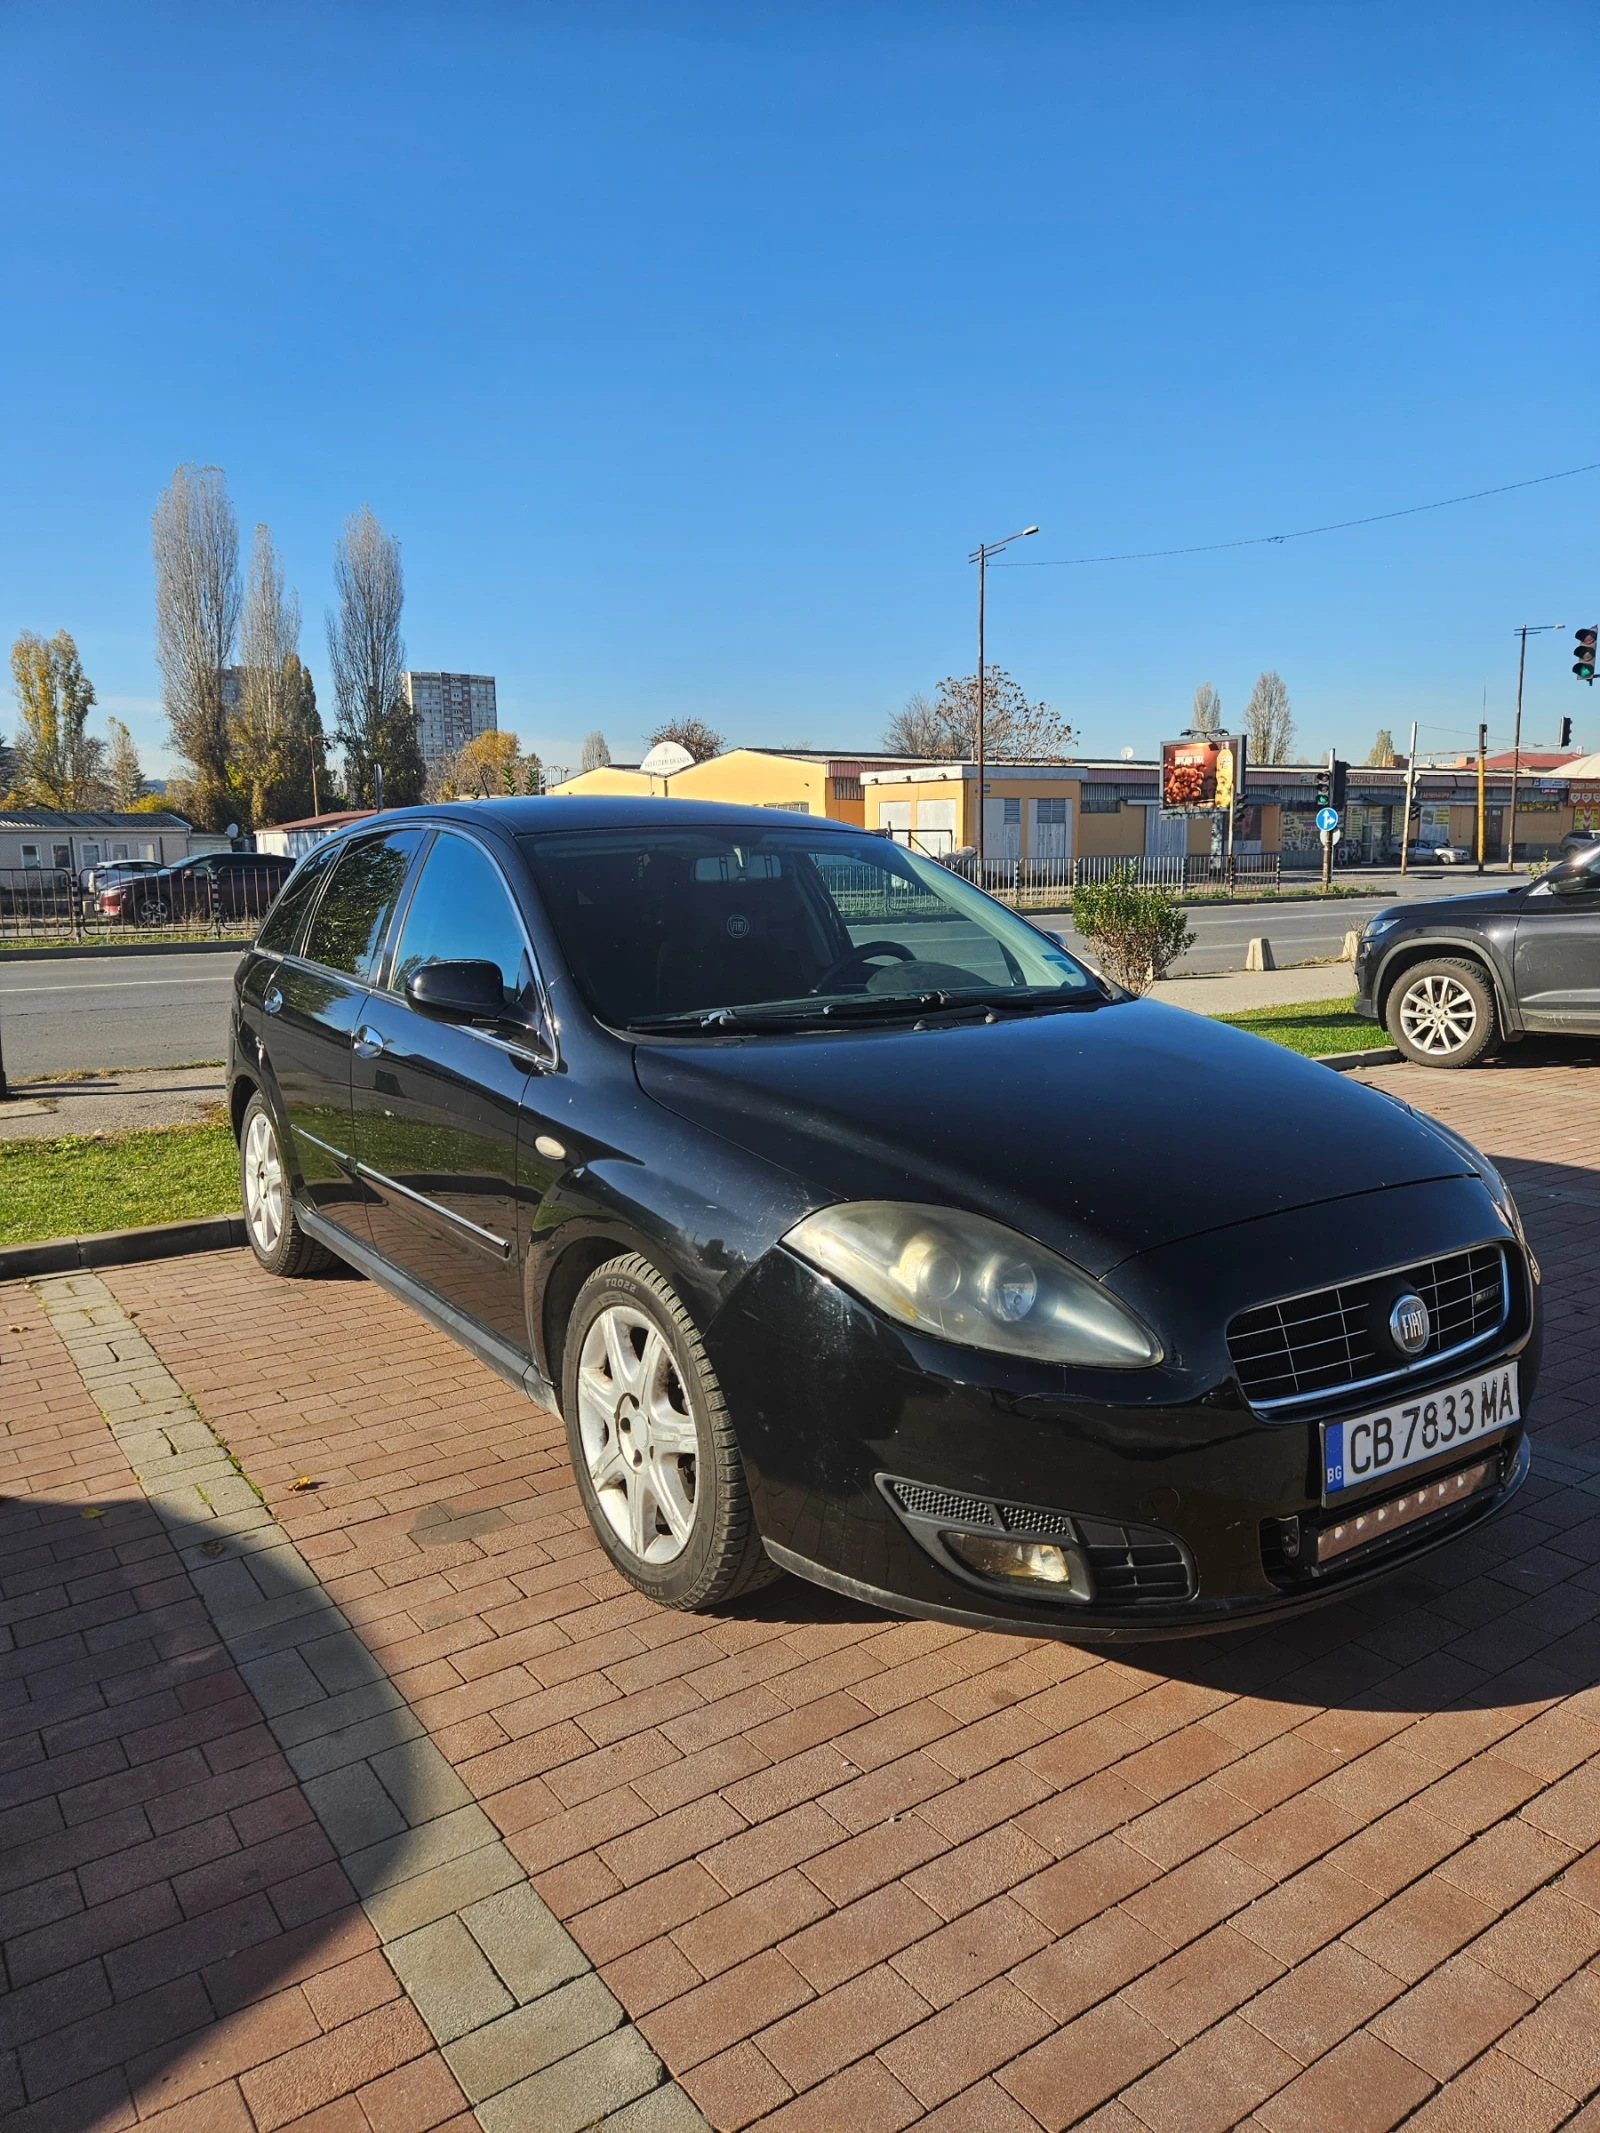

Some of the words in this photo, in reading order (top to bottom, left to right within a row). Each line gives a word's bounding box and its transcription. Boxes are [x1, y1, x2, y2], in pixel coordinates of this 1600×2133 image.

[605, 1278, 637, 1293] TQ022
[1401, 1308, 1424, 1340] FIAT
[1351, 1417, 1394, 1474] CB
[1402, 1388, 1474, 1459] 7833
[1481, 1372, 1514, 1428] MA
[1327, 1465, 1343, 1483] BG
